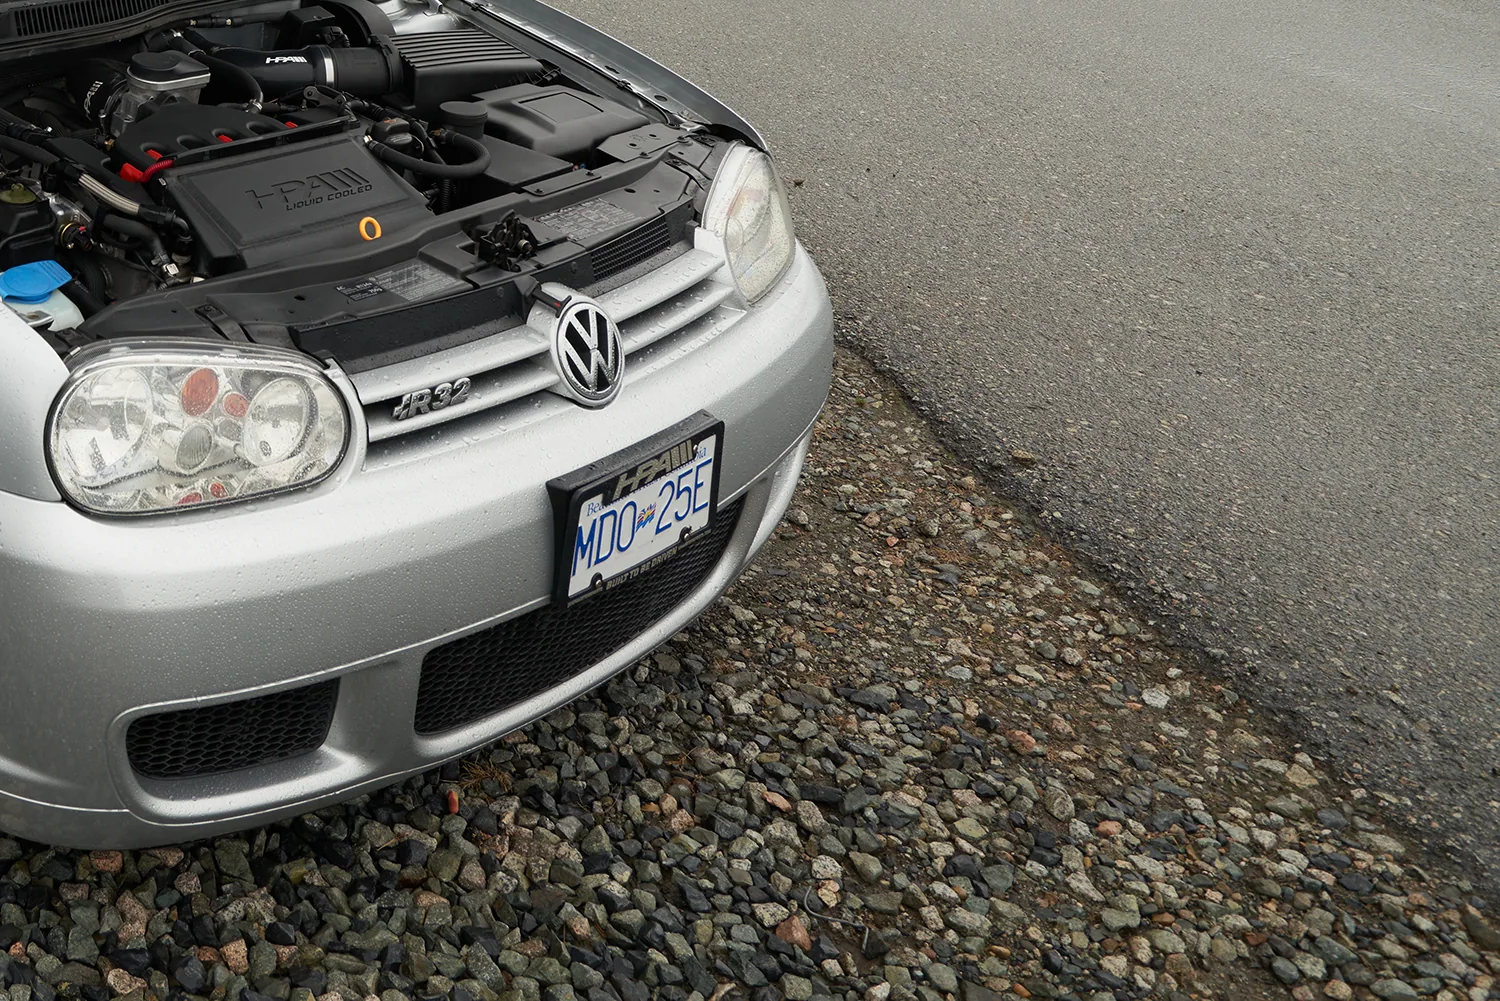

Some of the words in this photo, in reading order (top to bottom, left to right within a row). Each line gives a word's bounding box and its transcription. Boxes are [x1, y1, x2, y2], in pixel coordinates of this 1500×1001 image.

[286, 196, 323, 211] LIQUID
[327, 184, 373, 201] COOLED
[400, 377, 472, 418] R32
[655, 458, 712, 536] 25E
[606, 573, 629, 590] BUILT
[629, 567, 640, 579] TO
[640, 561, 651, 574] BE
[651, 546, 677, 568] DRIVEN
